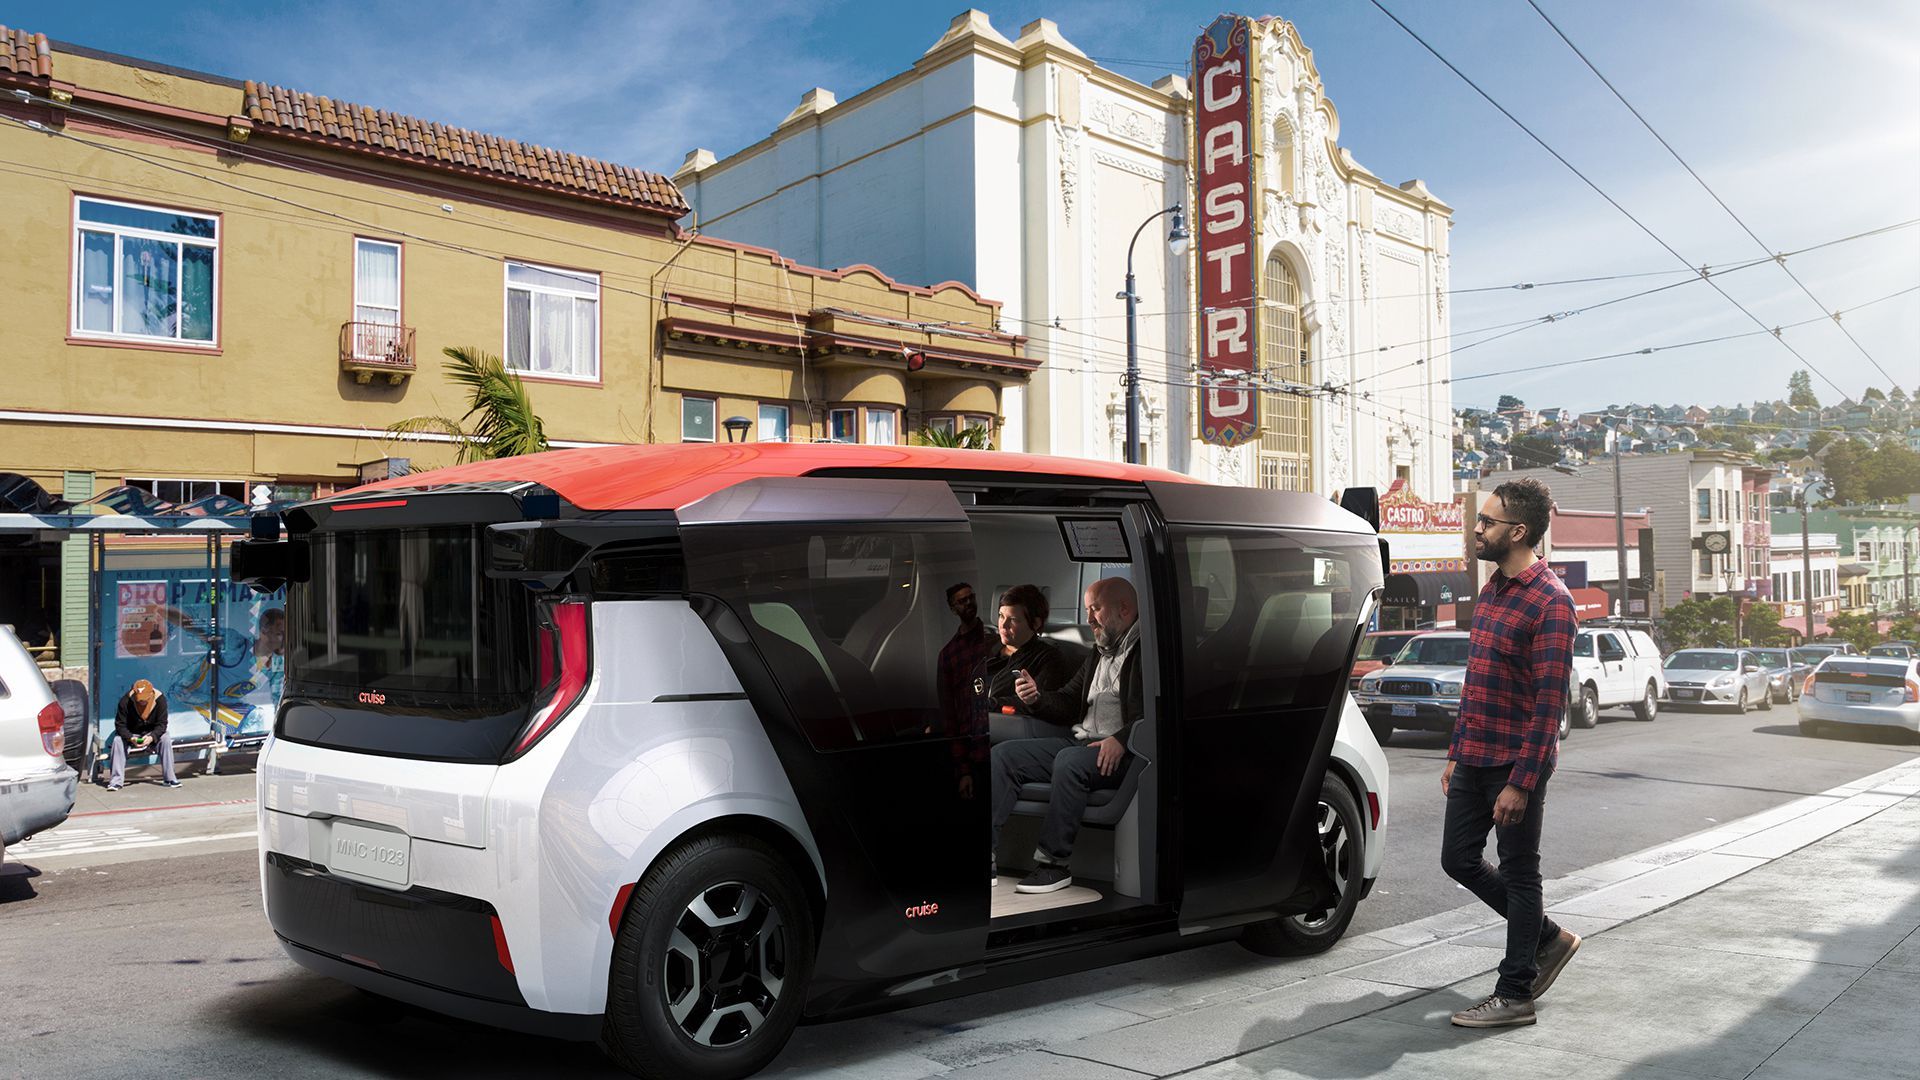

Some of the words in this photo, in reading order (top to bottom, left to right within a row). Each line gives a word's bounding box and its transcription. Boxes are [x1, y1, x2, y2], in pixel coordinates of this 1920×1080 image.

[1203, 59, 1249, 418] CASTRO
[1387, 507, 1424, 523] CASTRO
[118, 583, 186, 606] DROP
[359, 690, 386, 704] cruise
[336, 838, 367, 859] MNC
[371, 846, 405, 867] 1023
[905, 900, 939, 918] cruise
